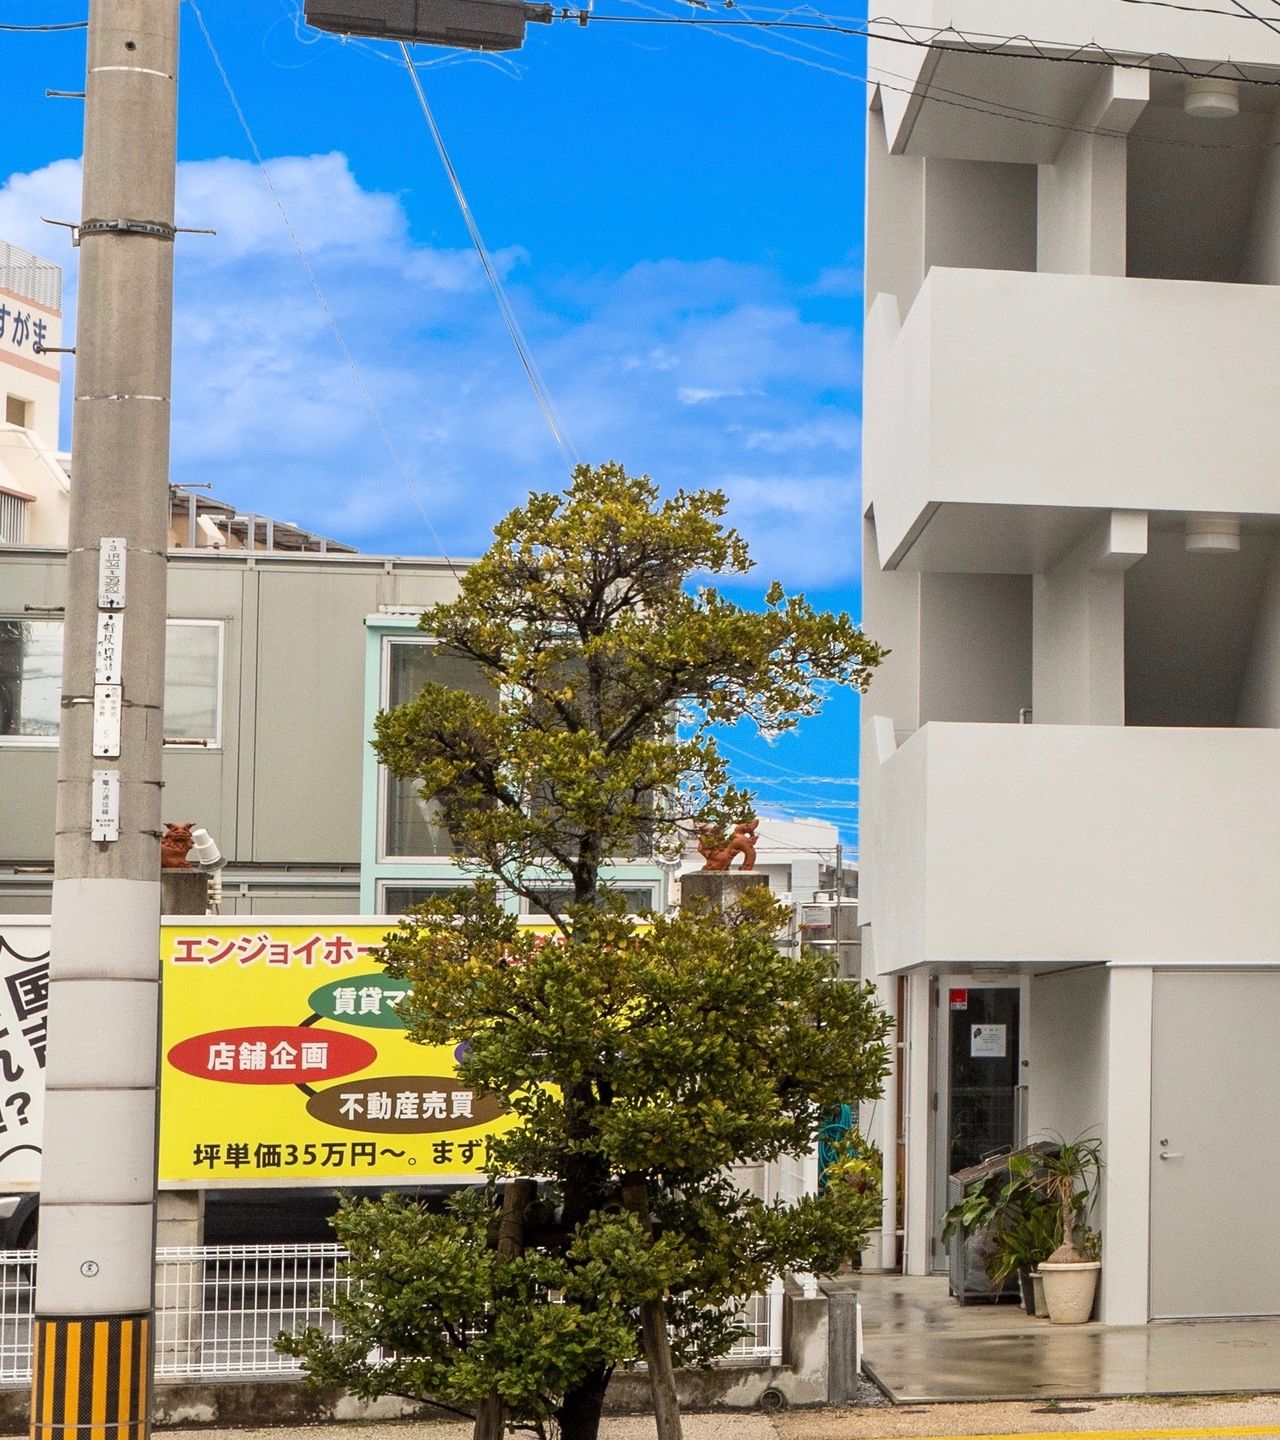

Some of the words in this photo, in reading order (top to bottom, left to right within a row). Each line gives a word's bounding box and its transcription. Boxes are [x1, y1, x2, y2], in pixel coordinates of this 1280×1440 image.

[332, 987, 414, 1016] 賃貸マ
[207, 1041, 329, 1071] 店舗企画
[339, 1091, 474, 1121] 不動産売買
